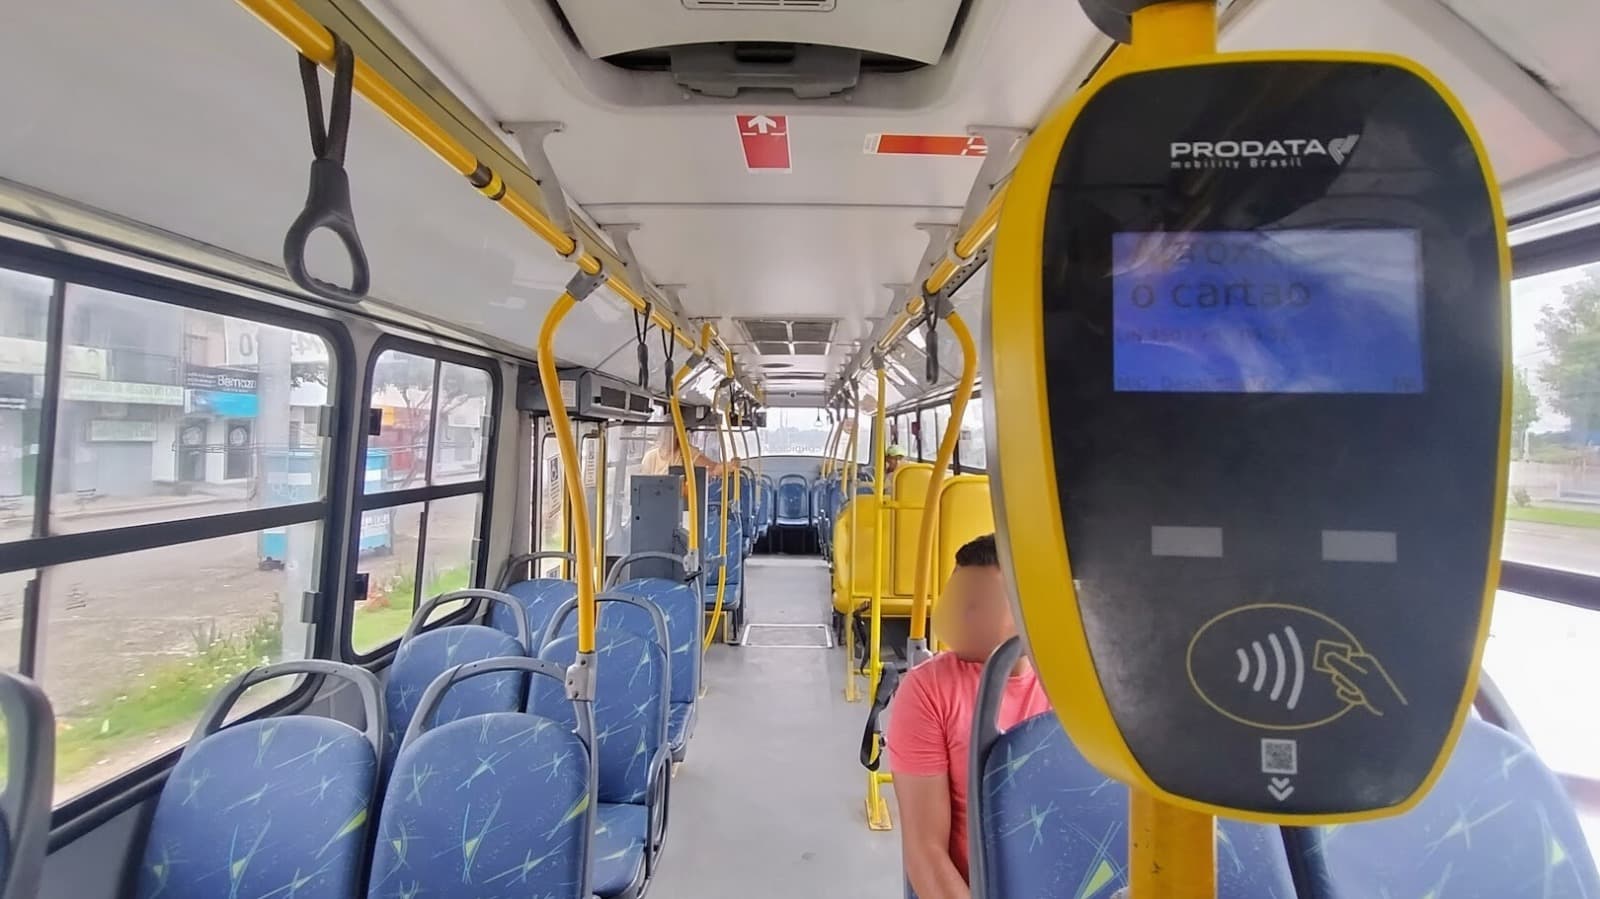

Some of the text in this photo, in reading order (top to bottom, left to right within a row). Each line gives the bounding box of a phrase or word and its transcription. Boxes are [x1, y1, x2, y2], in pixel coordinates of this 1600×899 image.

[1170, 139, 1327, 158] PRODATA
[1170, 157, 1302, 169] mobility Brasil
[1131, 283, 1154, 309] o
